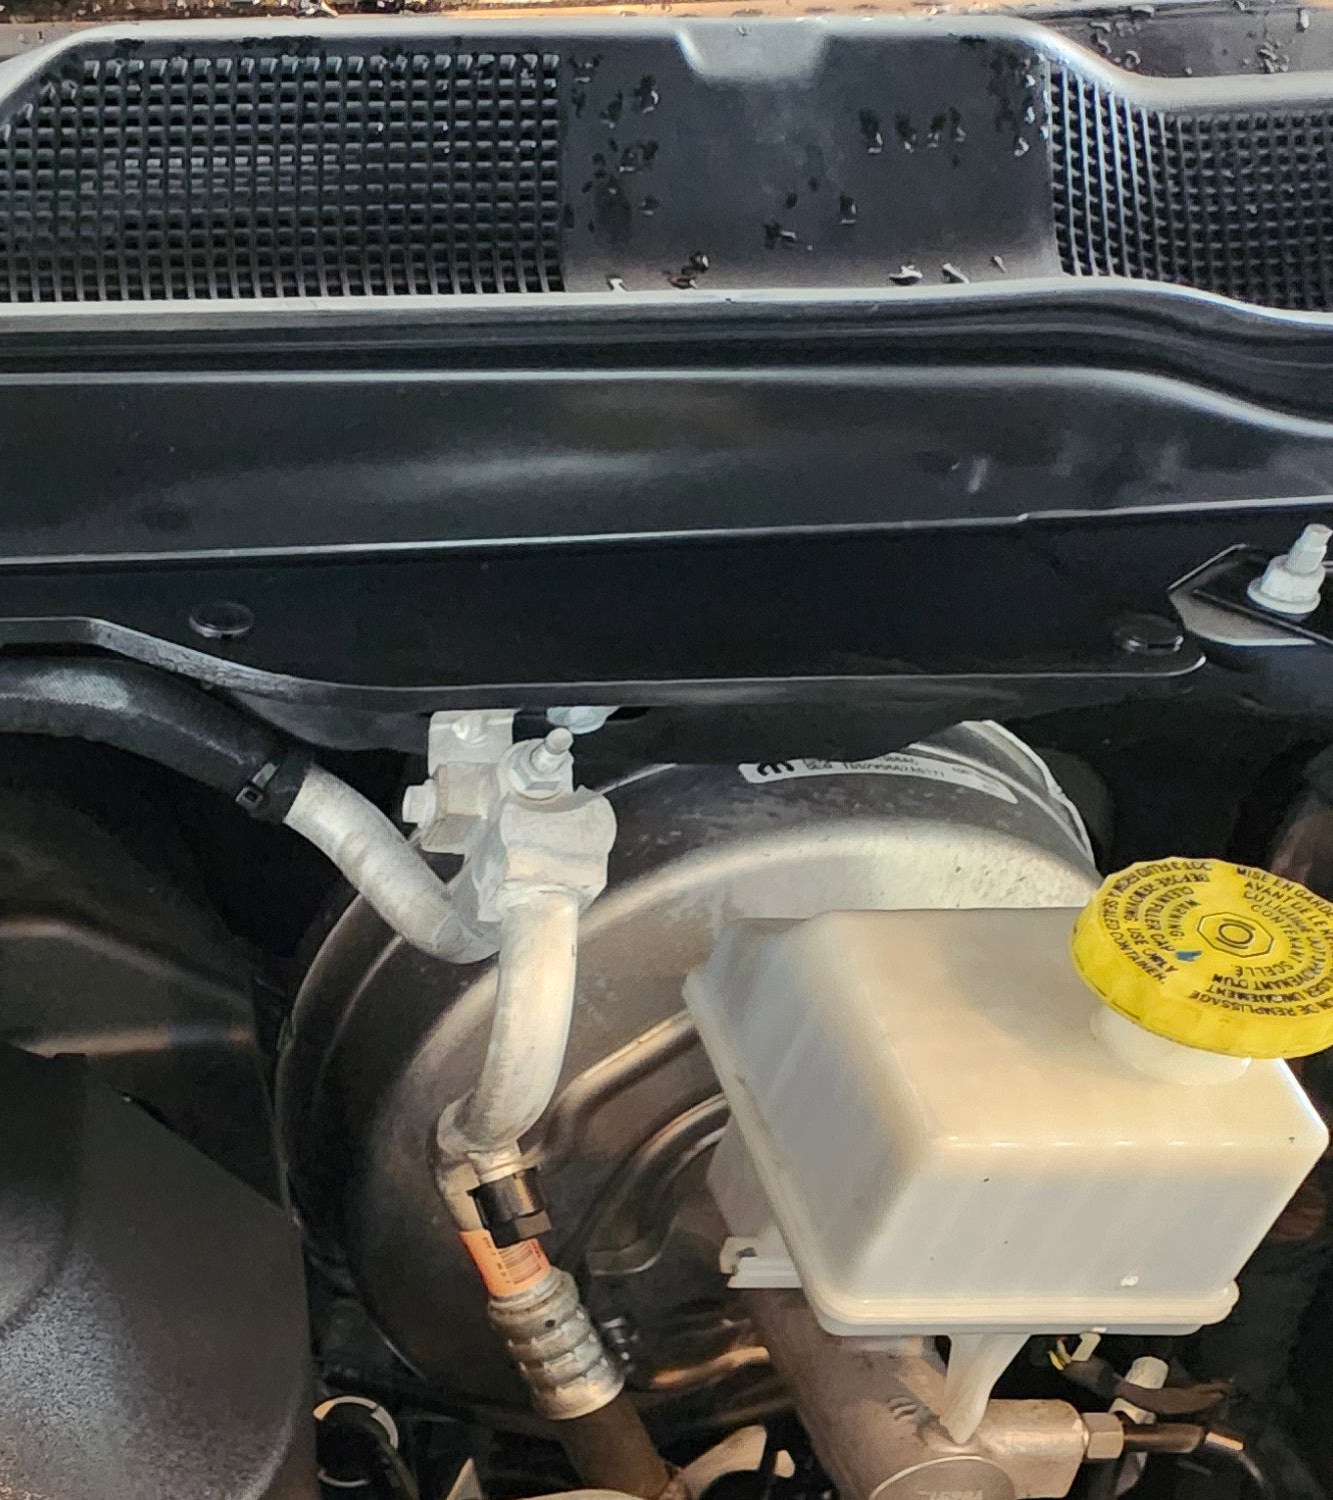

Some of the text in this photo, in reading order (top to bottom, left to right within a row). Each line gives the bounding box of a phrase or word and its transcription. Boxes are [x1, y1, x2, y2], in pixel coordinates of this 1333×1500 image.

[1236, 866, 1270, 883] MISE
[1271, 877, 1295, 892] EN
[1244, 880, 1291, 904] AVANT
[1126, 927, 1150, 946] USE
